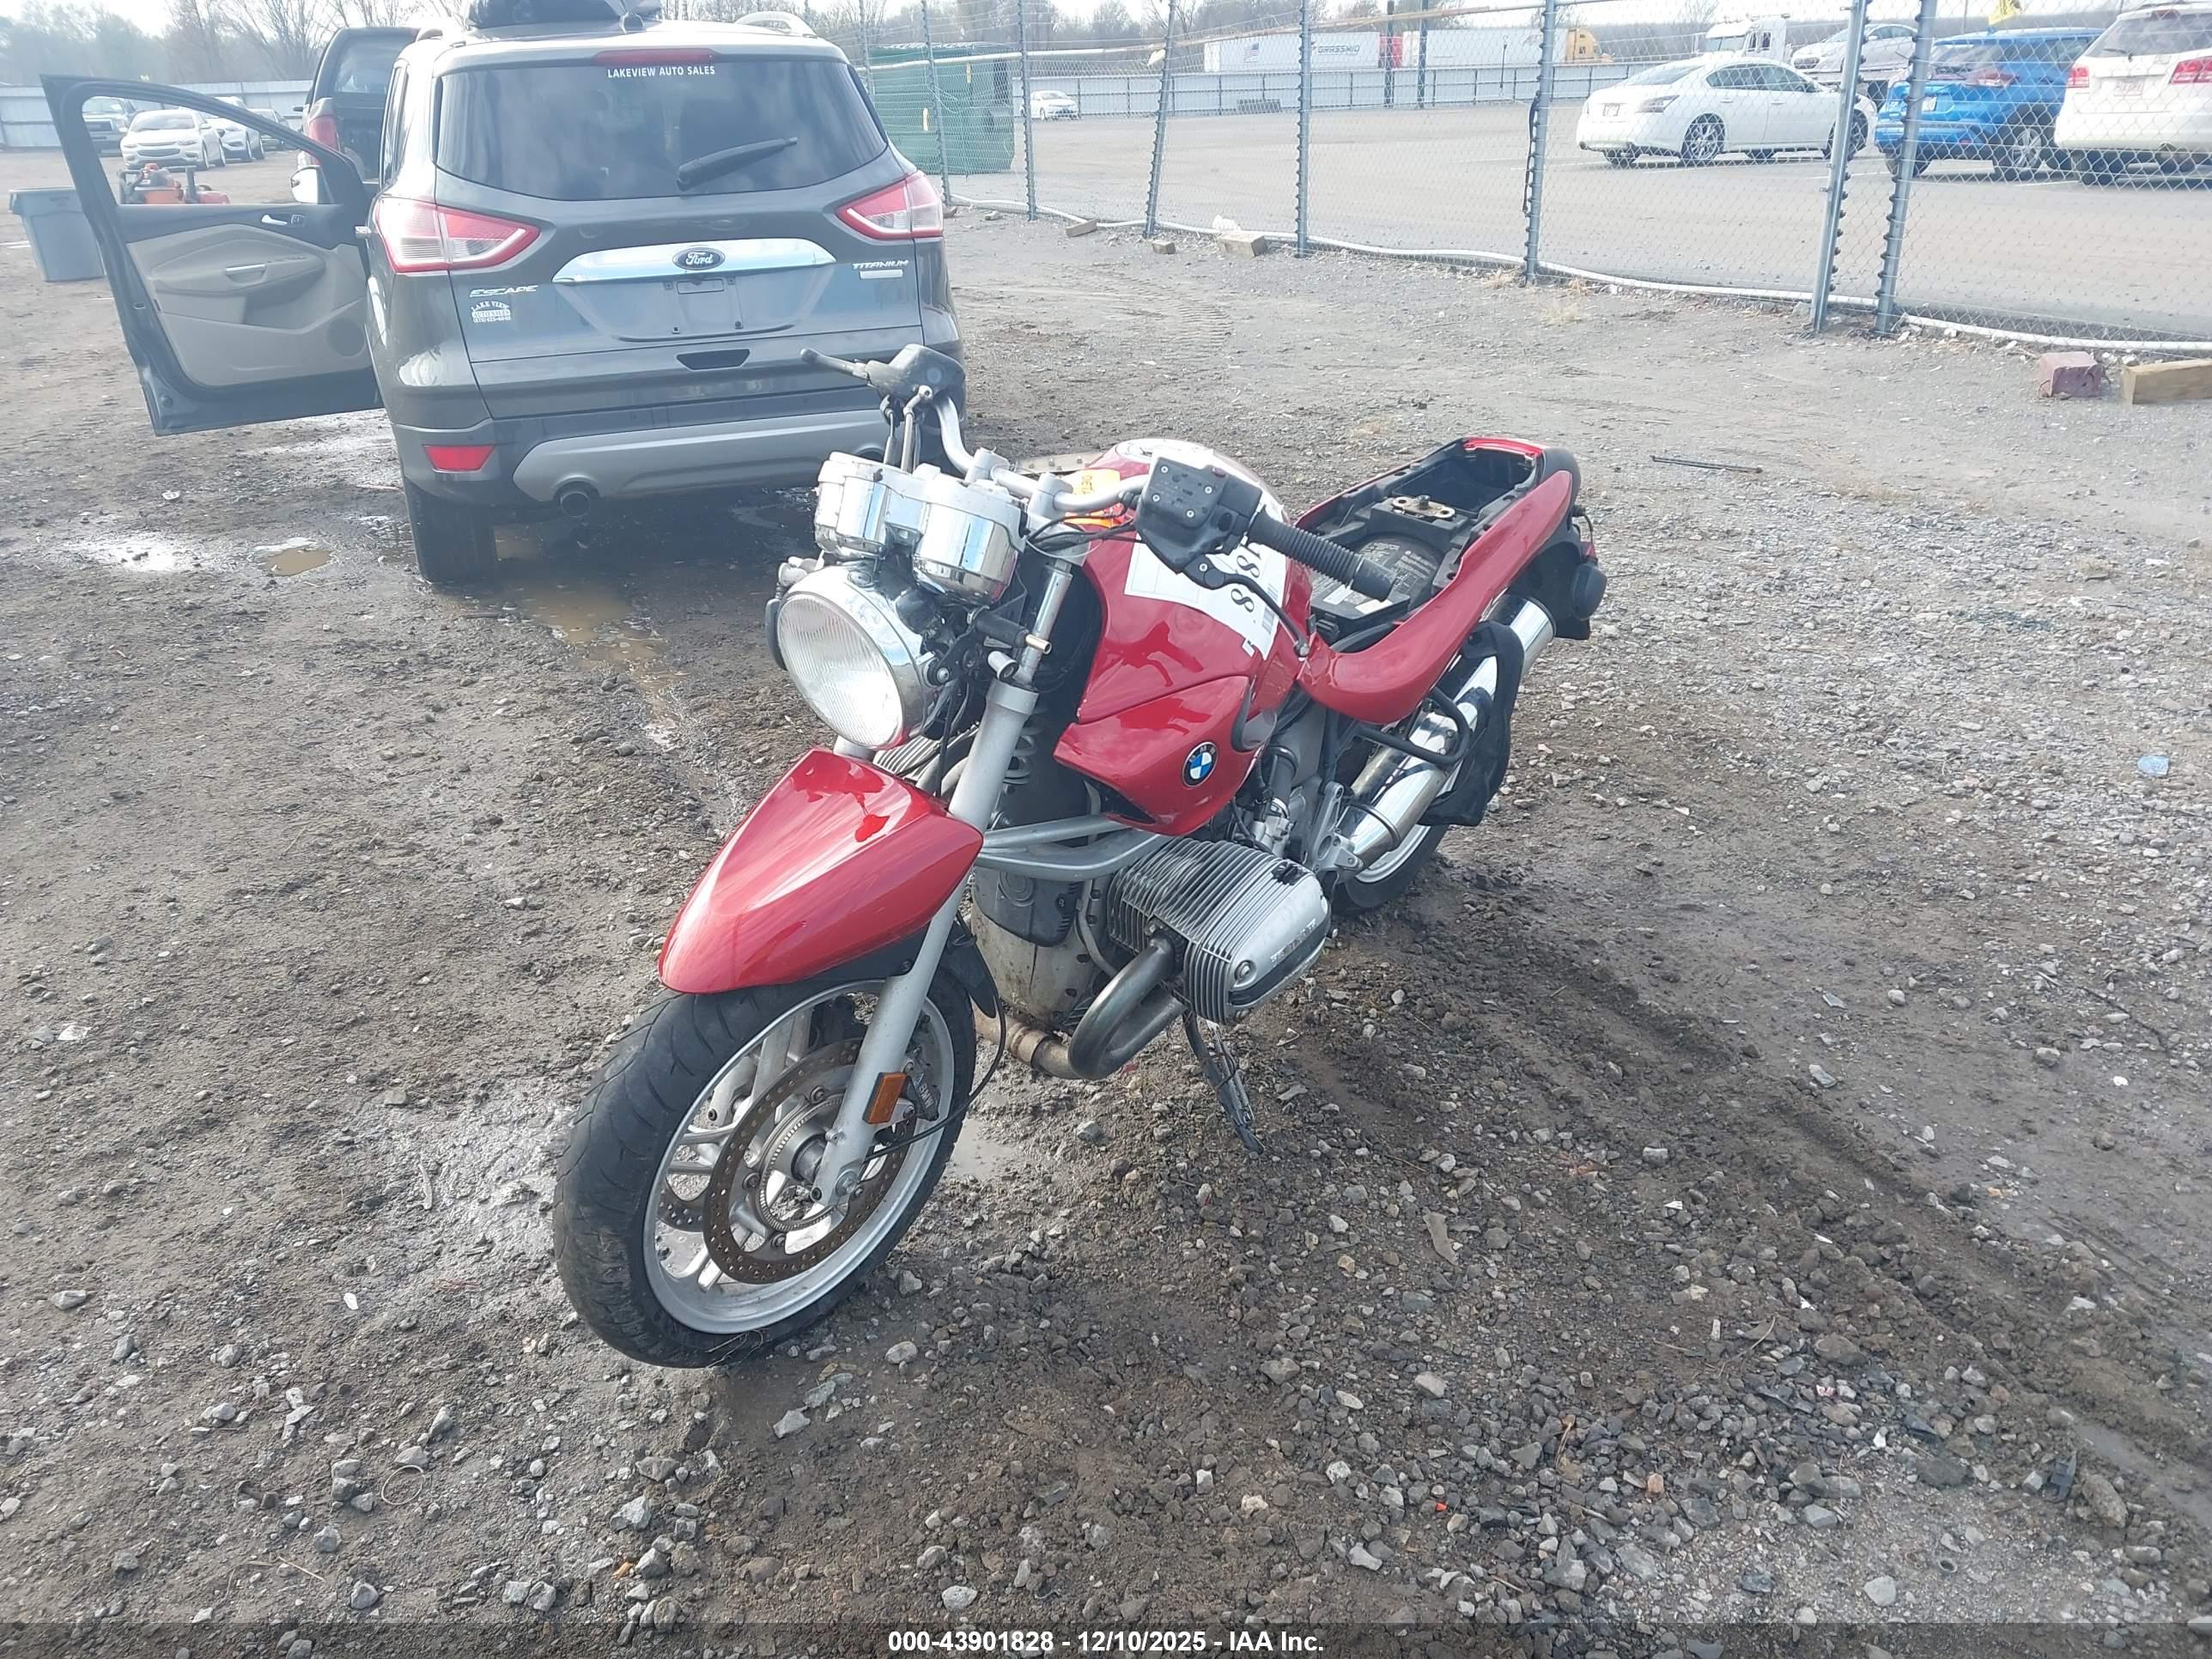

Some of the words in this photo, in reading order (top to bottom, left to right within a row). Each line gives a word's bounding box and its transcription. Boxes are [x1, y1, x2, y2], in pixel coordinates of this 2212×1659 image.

[607, 67, 656, 78] LAKEVIEW
[659, 66, 684, 76] AUTO
[687, 65, 715, 76] SALES
[685, 252, 714, 265] Ford
[852, 259, 909, 270] TITANIUM
[469, 285, 539, 298] ESCAPE
[471, 301, 490, 312] LAKE
[919, 1082, 934, 1109] BMW
